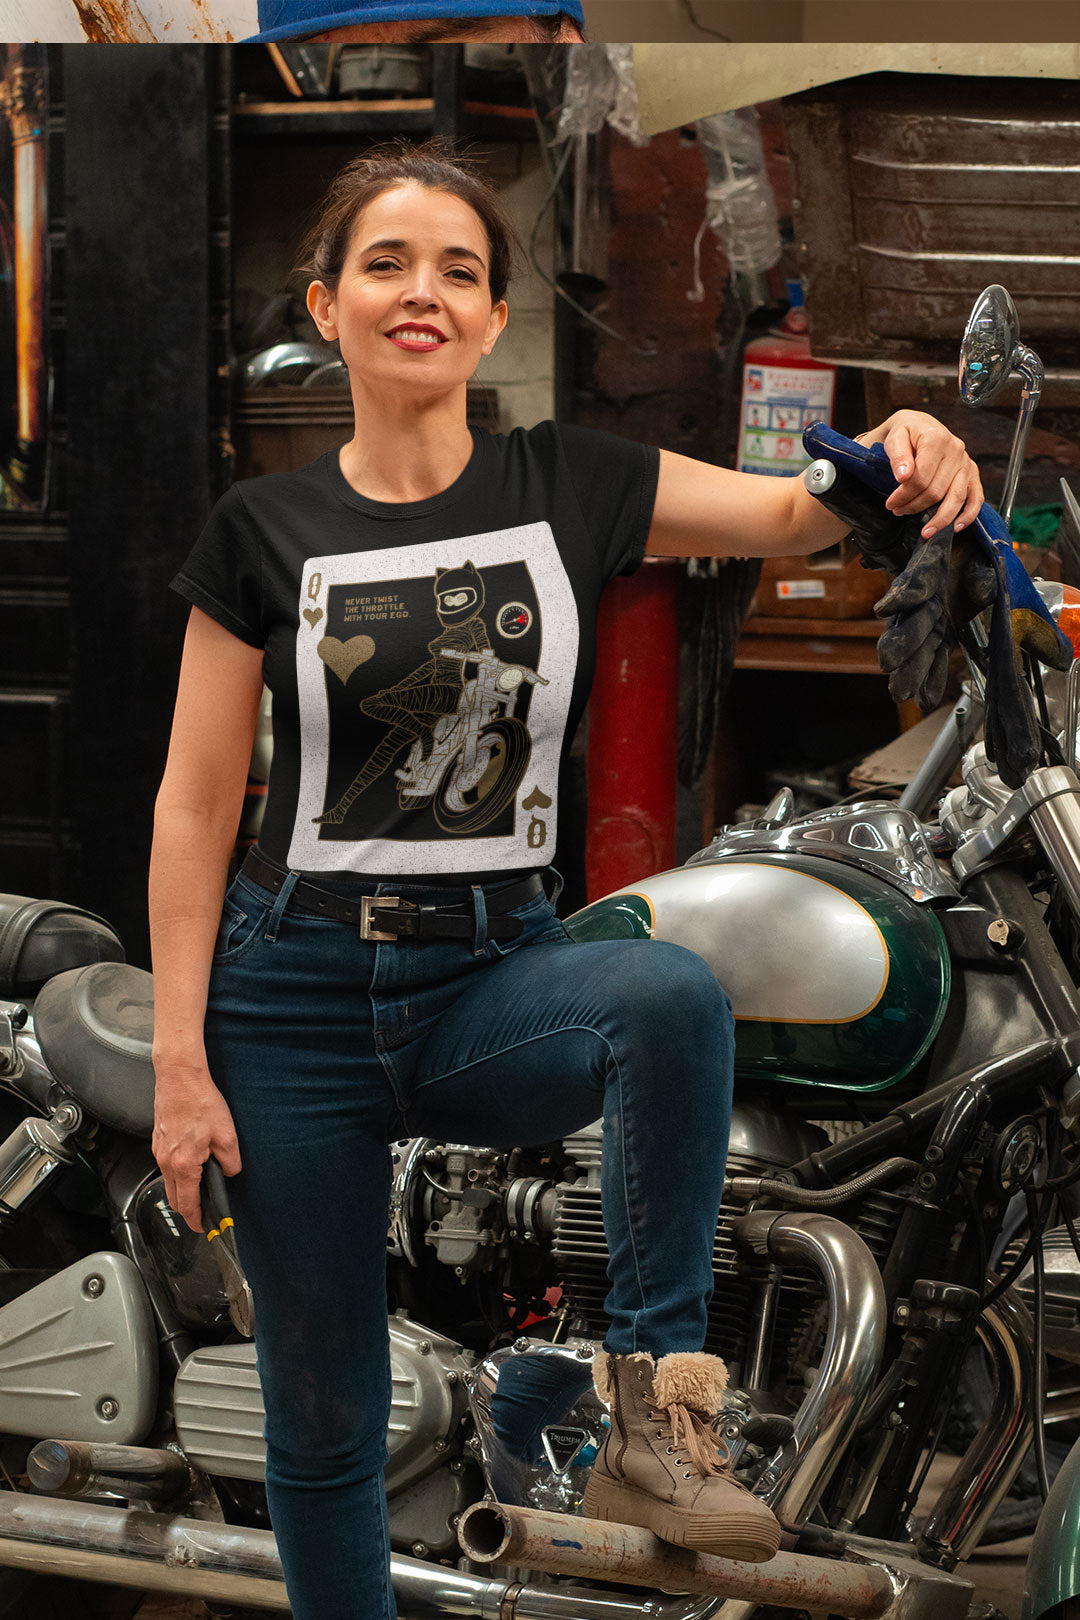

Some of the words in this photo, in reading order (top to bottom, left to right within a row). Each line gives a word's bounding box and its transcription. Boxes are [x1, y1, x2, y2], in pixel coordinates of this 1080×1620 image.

[308, 573, 322, 603] Q
[345, 598, 371, 606] NEVER
[373, 595, 398, 603] TWIST
[345, 606, 359, 614] THE
[361, 603, 405, 613] THROTTLE
[343, 615, 362, 623] WITH
[364, 613, 388, 621] YOUR
[550, 1432, 581, 1445] TRIUMPH
